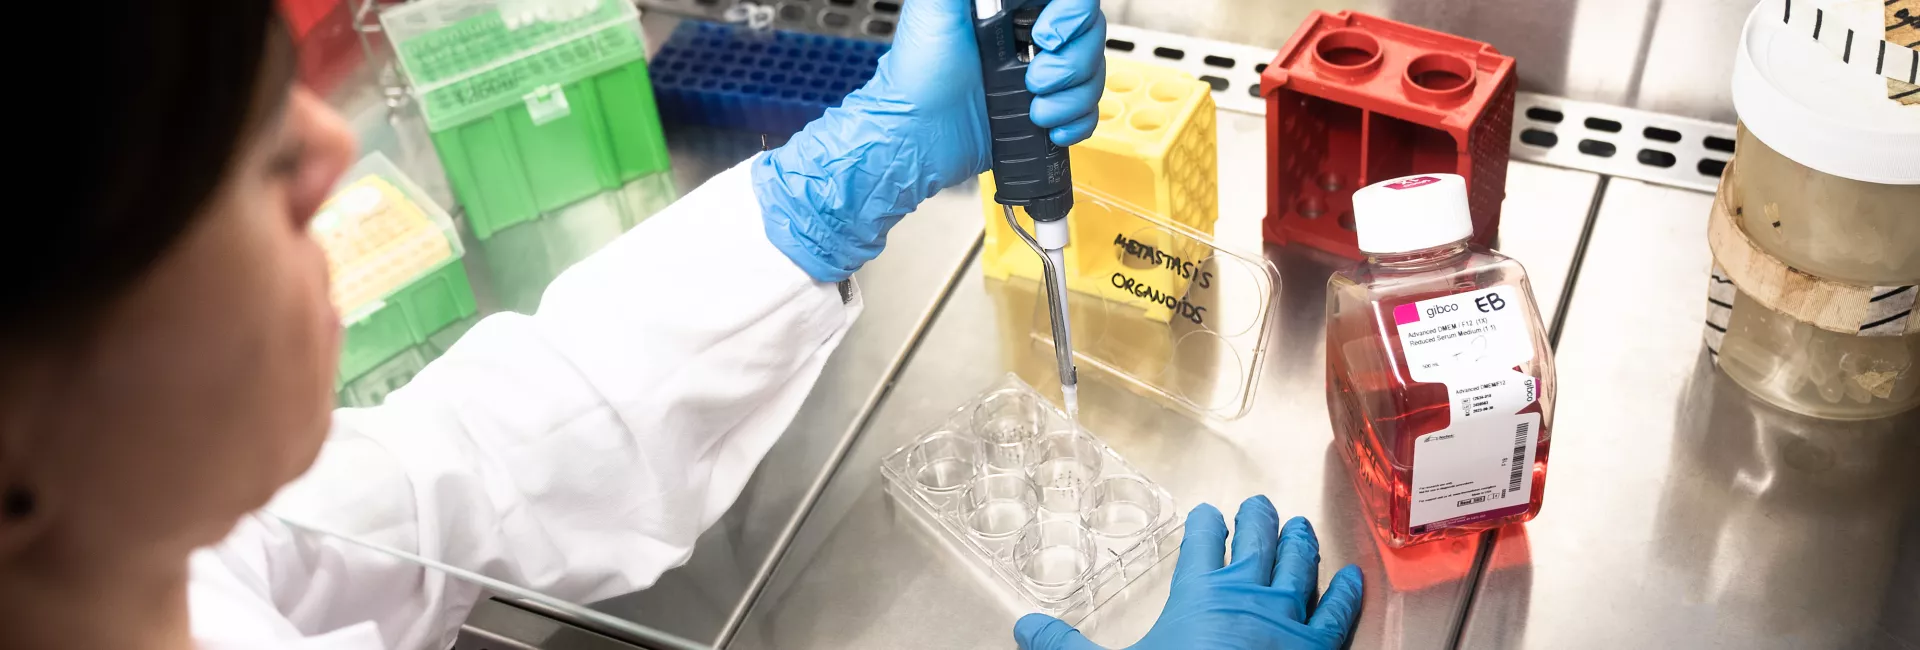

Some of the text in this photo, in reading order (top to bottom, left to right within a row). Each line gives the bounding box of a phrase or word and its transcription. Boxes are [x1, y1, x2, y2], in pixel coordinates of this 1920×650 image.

[1426, 302, 1459, 318] gibco
[1474, 292, 1506, 313] EB
[1408, 327, 1436, 338] Advanced
[1438, 323, 1457, 333] DMEM
[1410, 324, 1497, 347] Reduced Serum Medium (11)
[1456, 385, 1479, 395] Advanced
[1524, 380, 1534, 402] gibco
